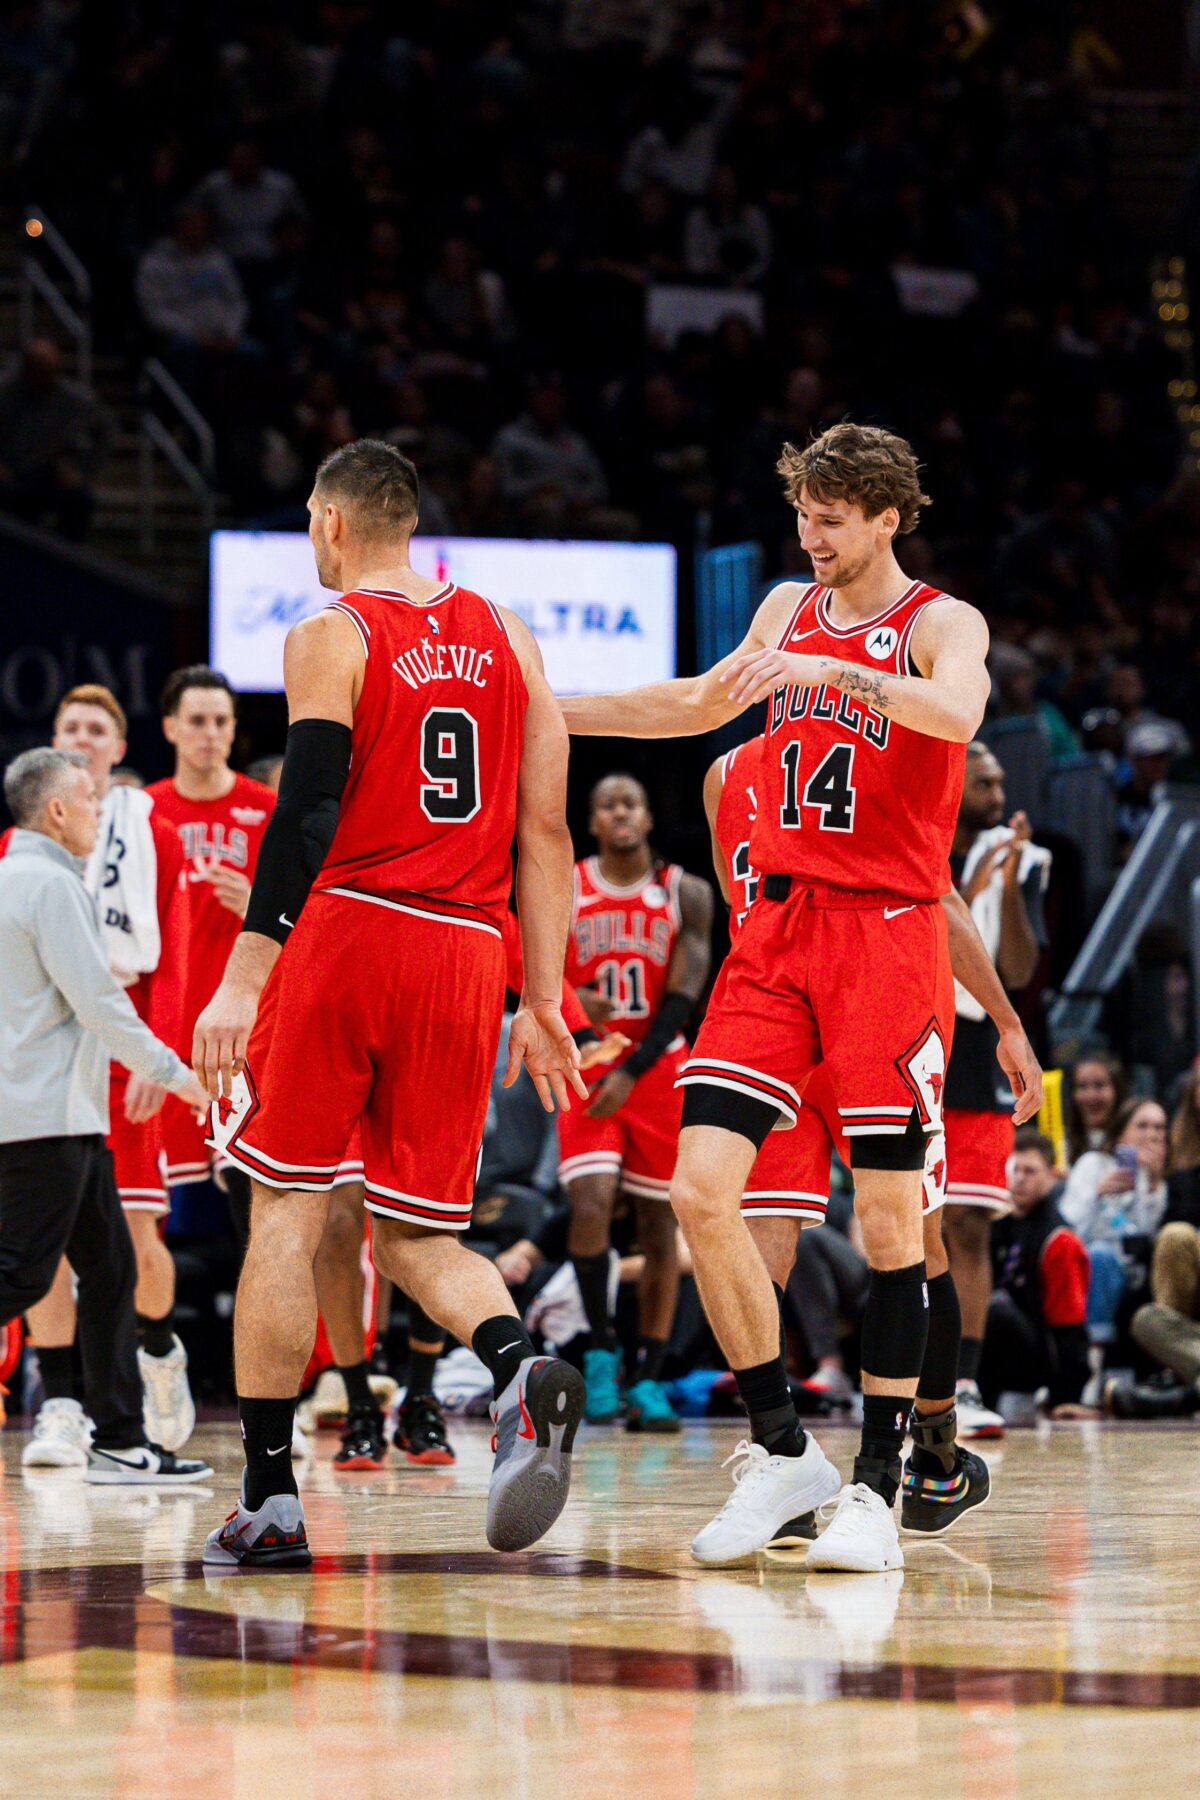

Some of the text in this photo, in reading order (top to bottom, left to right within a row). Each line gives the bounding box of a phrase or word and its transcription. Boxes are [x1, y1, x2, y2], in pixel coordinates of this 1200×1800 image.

[391, 636, 494, 690] VUČEVIĆ
[419, 706, 482, 823] 9
[779, 739, 857, 834] 14
[576, 909, 672, 967] BULLS
[595, 958, 650, 1019] 11
